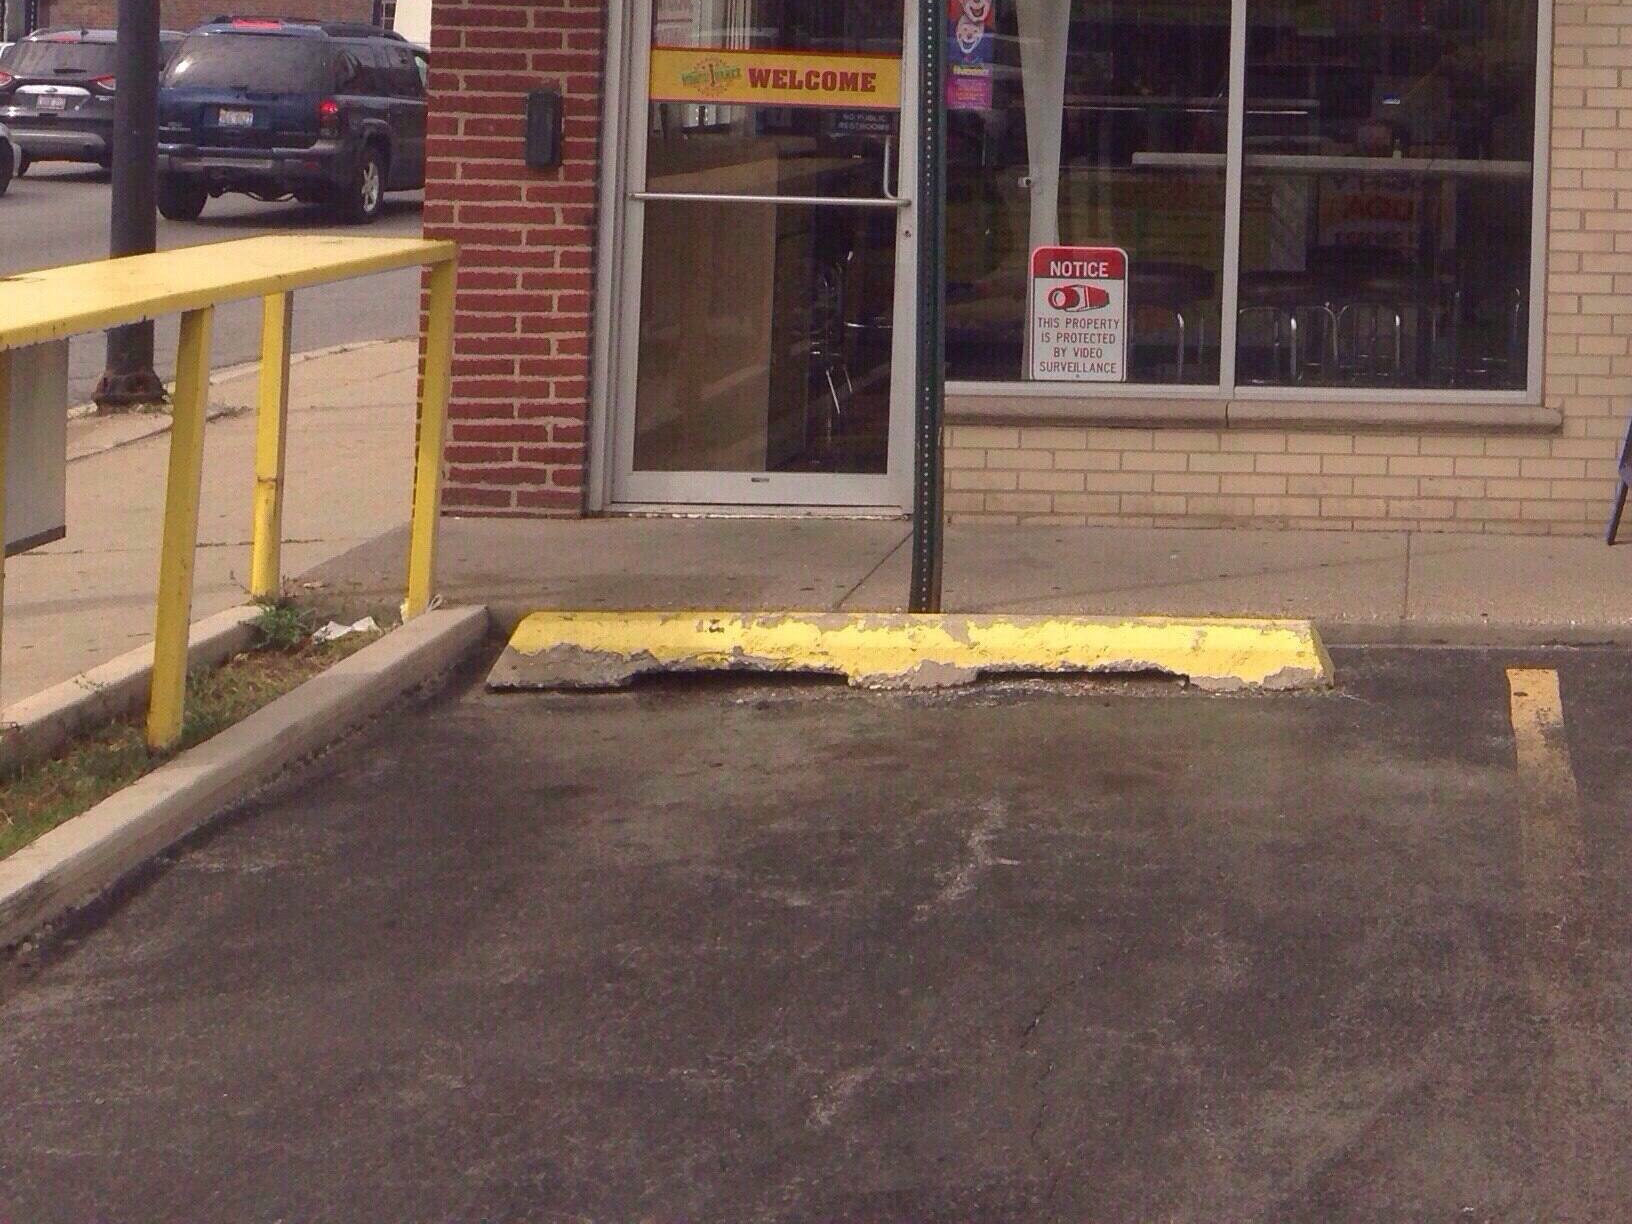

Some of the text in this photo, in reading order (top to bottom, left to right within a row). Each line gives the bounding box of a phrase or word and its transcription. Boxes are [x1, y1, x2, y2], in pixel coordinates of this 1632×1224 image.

[748, 67, 877, 93] WELCOME
[1050, 261, 1109, 277] NOTICE
[1038, 317, 1120, 330] THIS PROPERTY
[1041, 333, 1116, 344] IS PROTECTED
[1053, 347, 1103, 359] BY VIDEO
[1039, 361, 1117, 374] SURVEILLANCE
